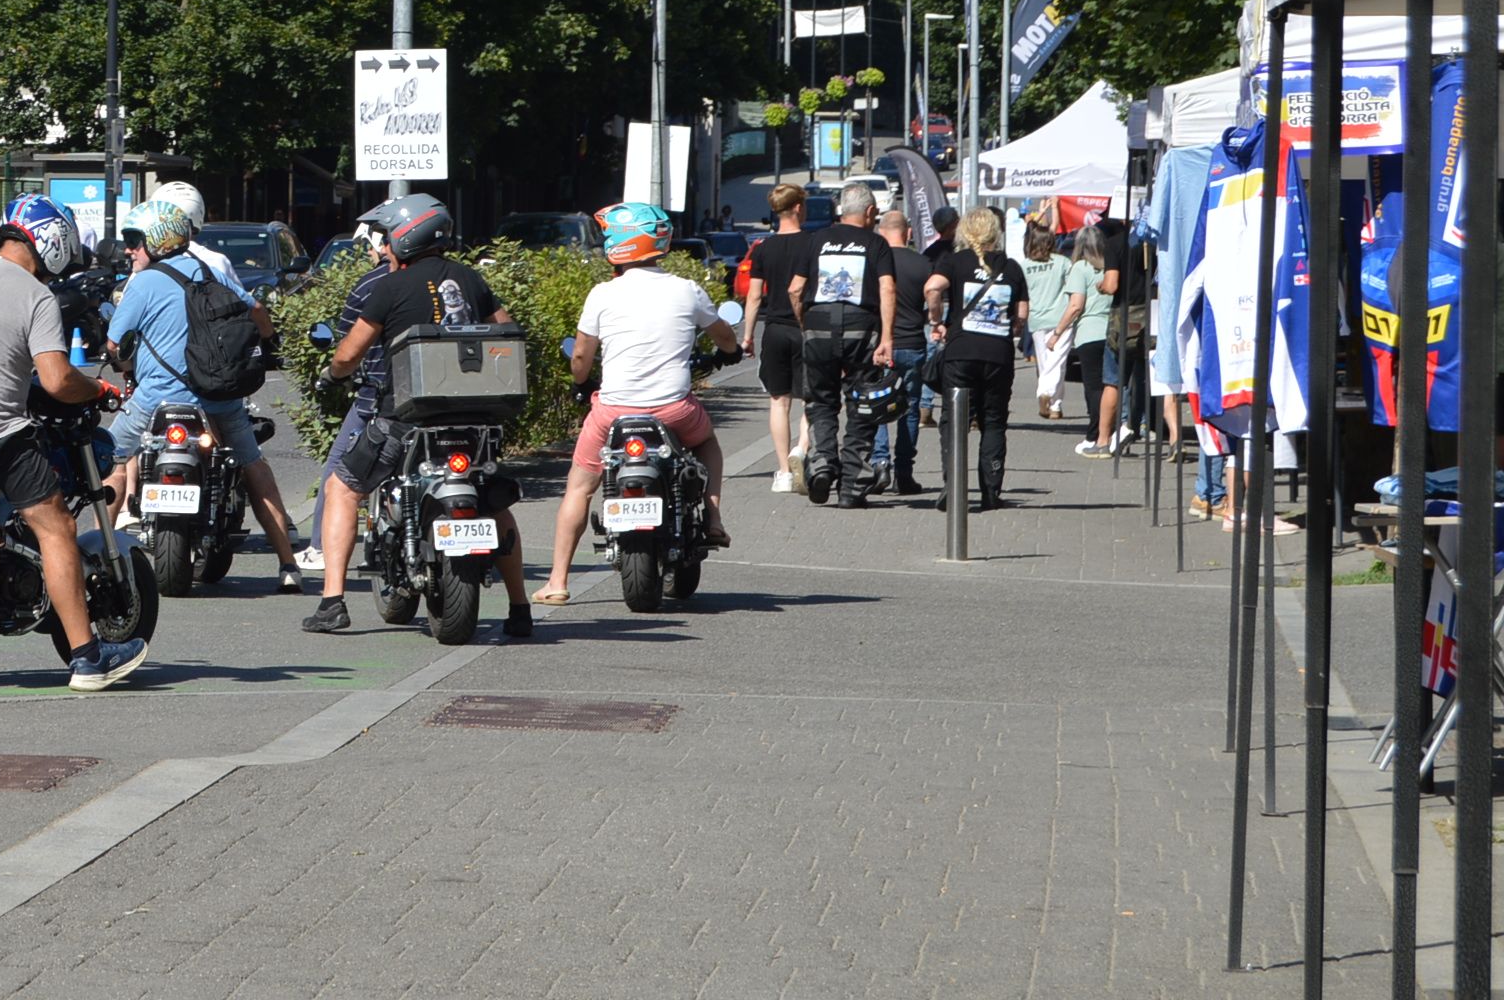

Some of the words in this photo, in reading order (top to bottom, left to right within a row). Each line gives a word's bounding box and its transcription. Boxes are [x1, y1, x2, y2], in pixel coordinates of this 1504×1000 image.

[363, 143, 440, 155] RECOLLIDA
[370, 158, 434, 170] DORSALS
[1011, 167, 1060, 178] Andorra
[1011, 178, 1022, 188] la
[1025, 178, 1055, 188] Vella
[1026, 262, 1054, 274] STAFF
[160, 489, 196, 502] R1142
[453, 523, 493, 538] P7502
